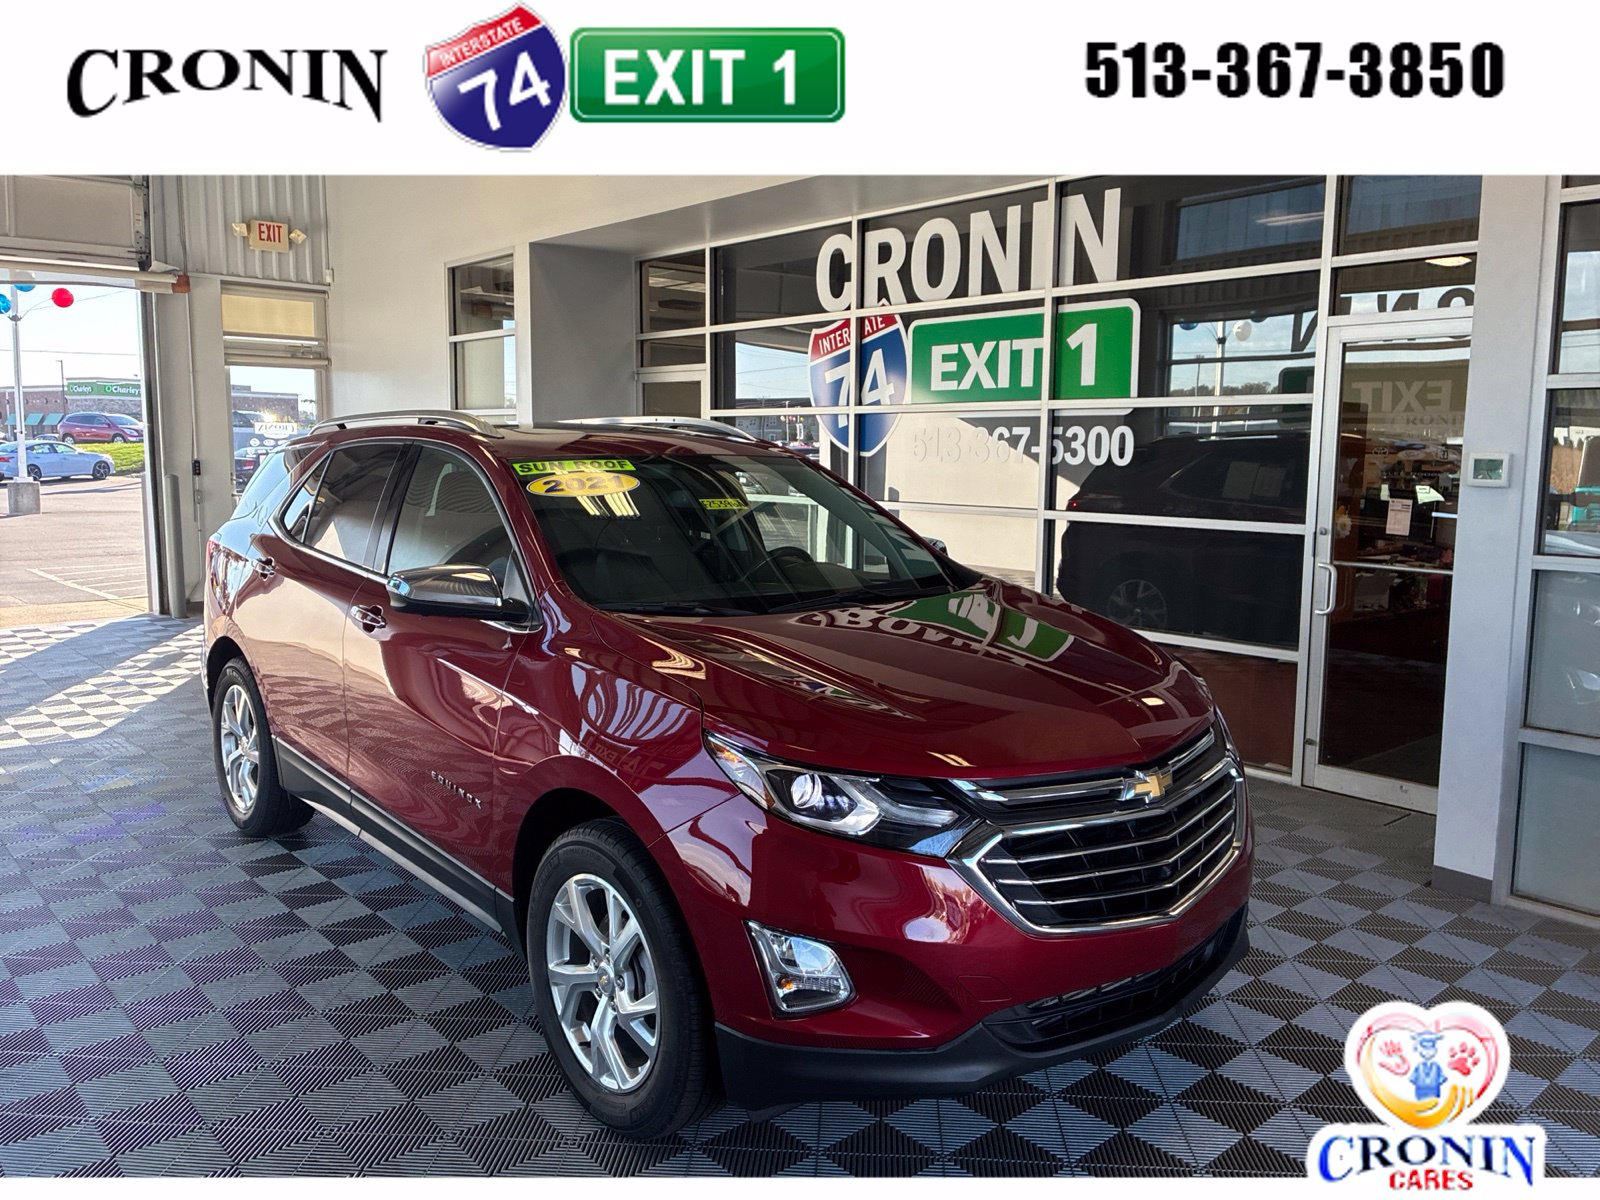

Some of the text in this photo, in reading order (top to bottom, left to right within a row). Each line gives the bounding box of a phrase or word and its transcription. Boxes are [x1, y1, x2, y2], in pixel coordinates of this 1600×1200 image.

[258, 223, 282, 243] EXIT
[816, 188, 1121, 311] CRONIN
[931, 323, 1097, 391] EXIT 1
[825, 348, 894, 428] 74
[518, 460, 629, 473] SUN ROOF
[543, 475, 624, 493] 2021
[431, 770, 482, 809] EQUINOX
